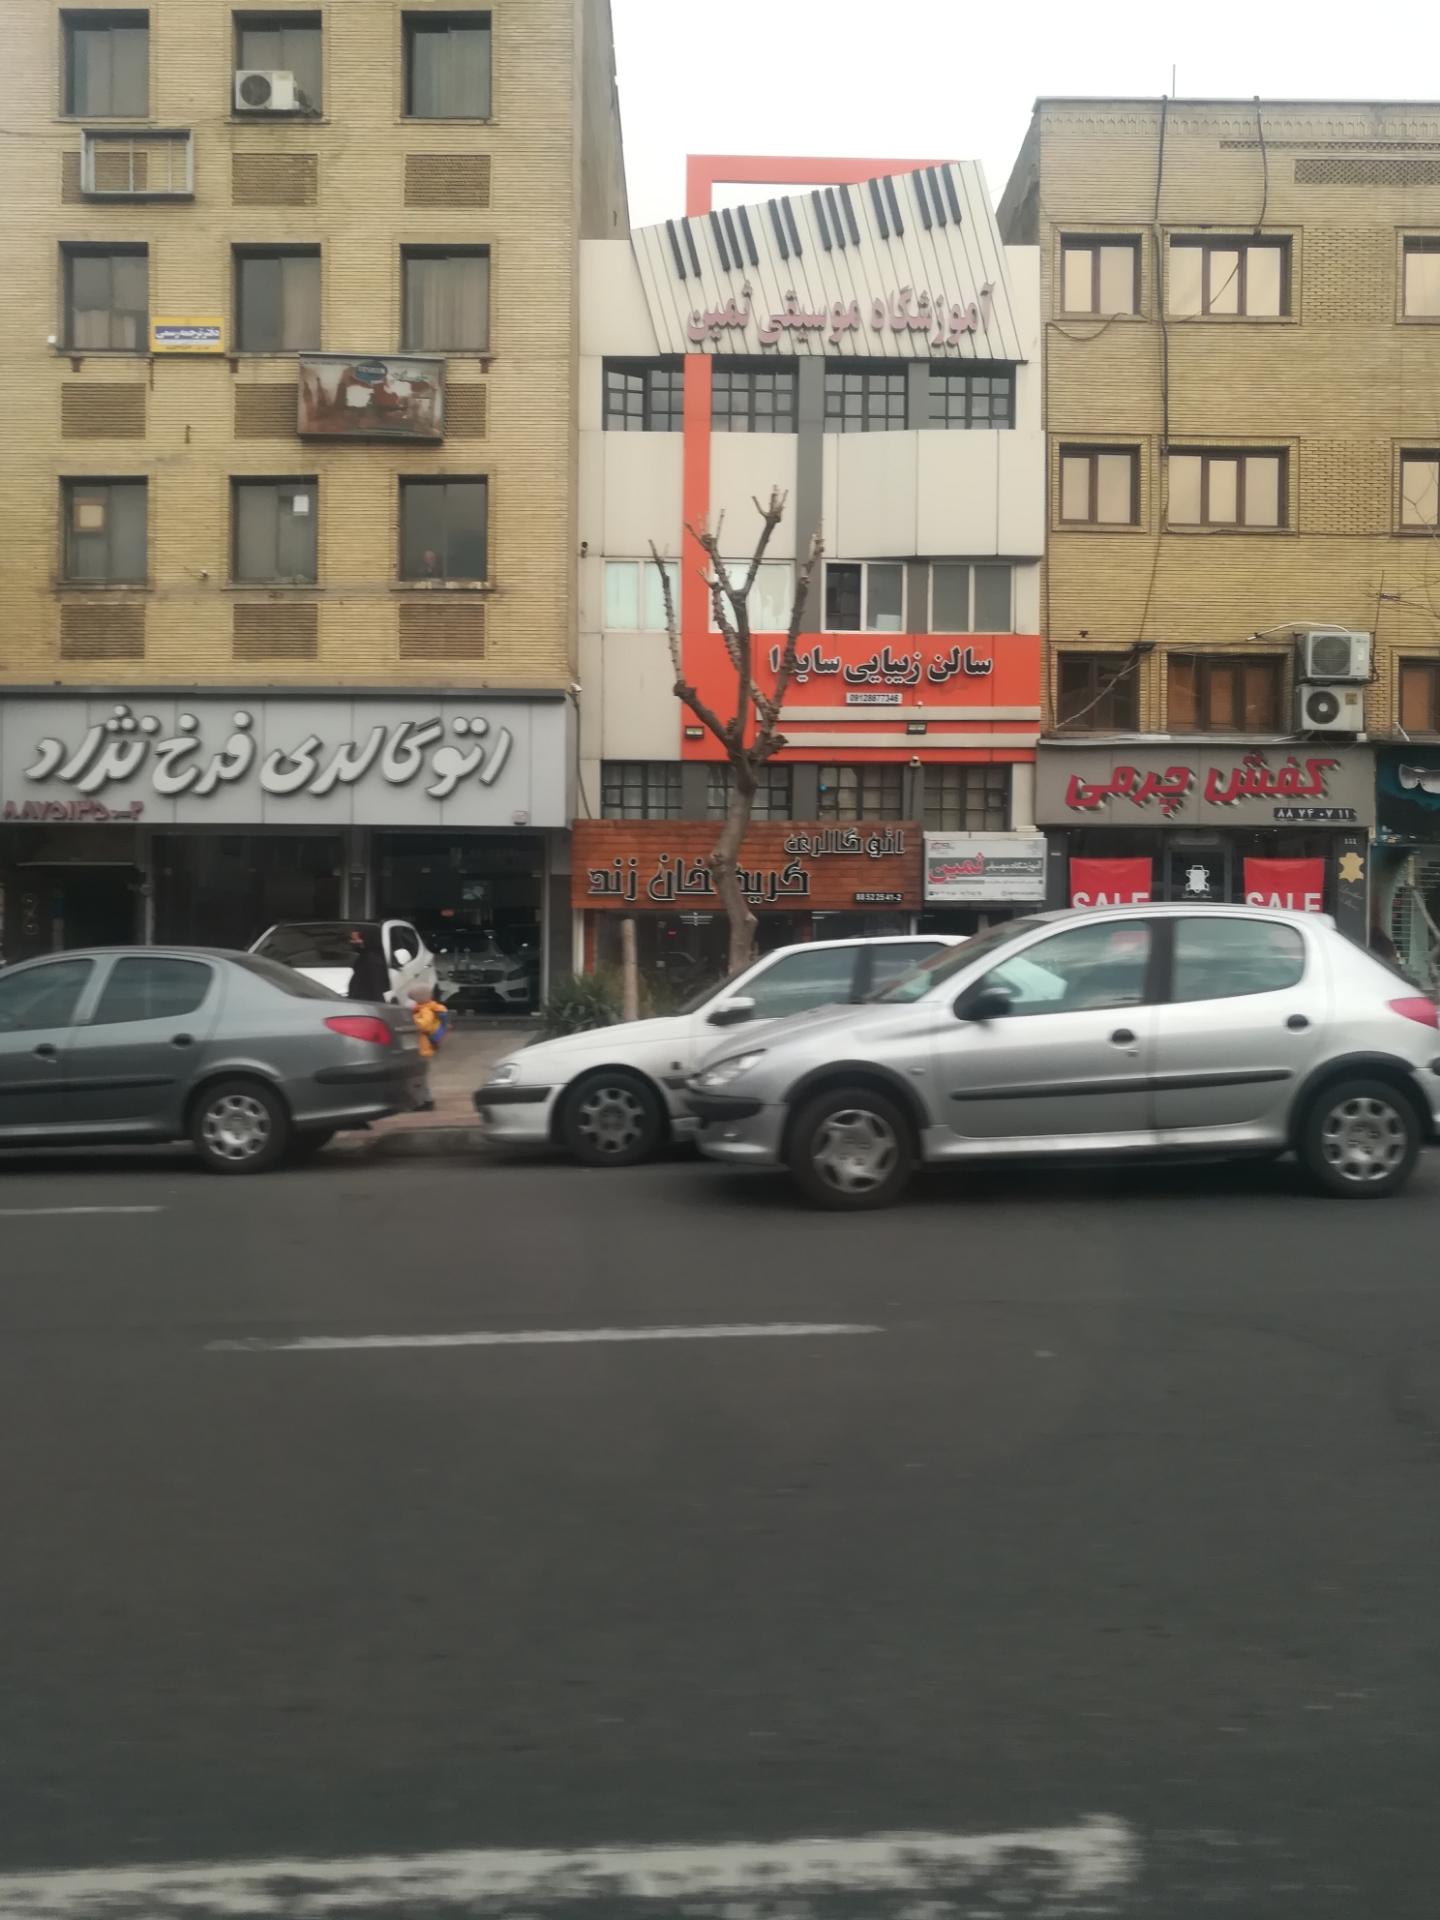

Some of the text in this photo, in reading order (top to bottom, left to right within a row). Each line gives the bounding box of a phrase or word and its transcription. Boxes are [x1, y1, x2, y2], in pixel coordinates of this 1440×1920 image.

[758, 289, 861, 346] موسیقی
[871, 281, 996, 348] آموزشگاه
[769, 645, 993, 684] سالن زیبایی سایا
[24, 704, 513, 799] اتو گالری فرخ نژاد
[1064, 750, 1341, 819] کفش چرمی
[587, 857, 639, 902] زند
[647, 853, 718, 902] خان
